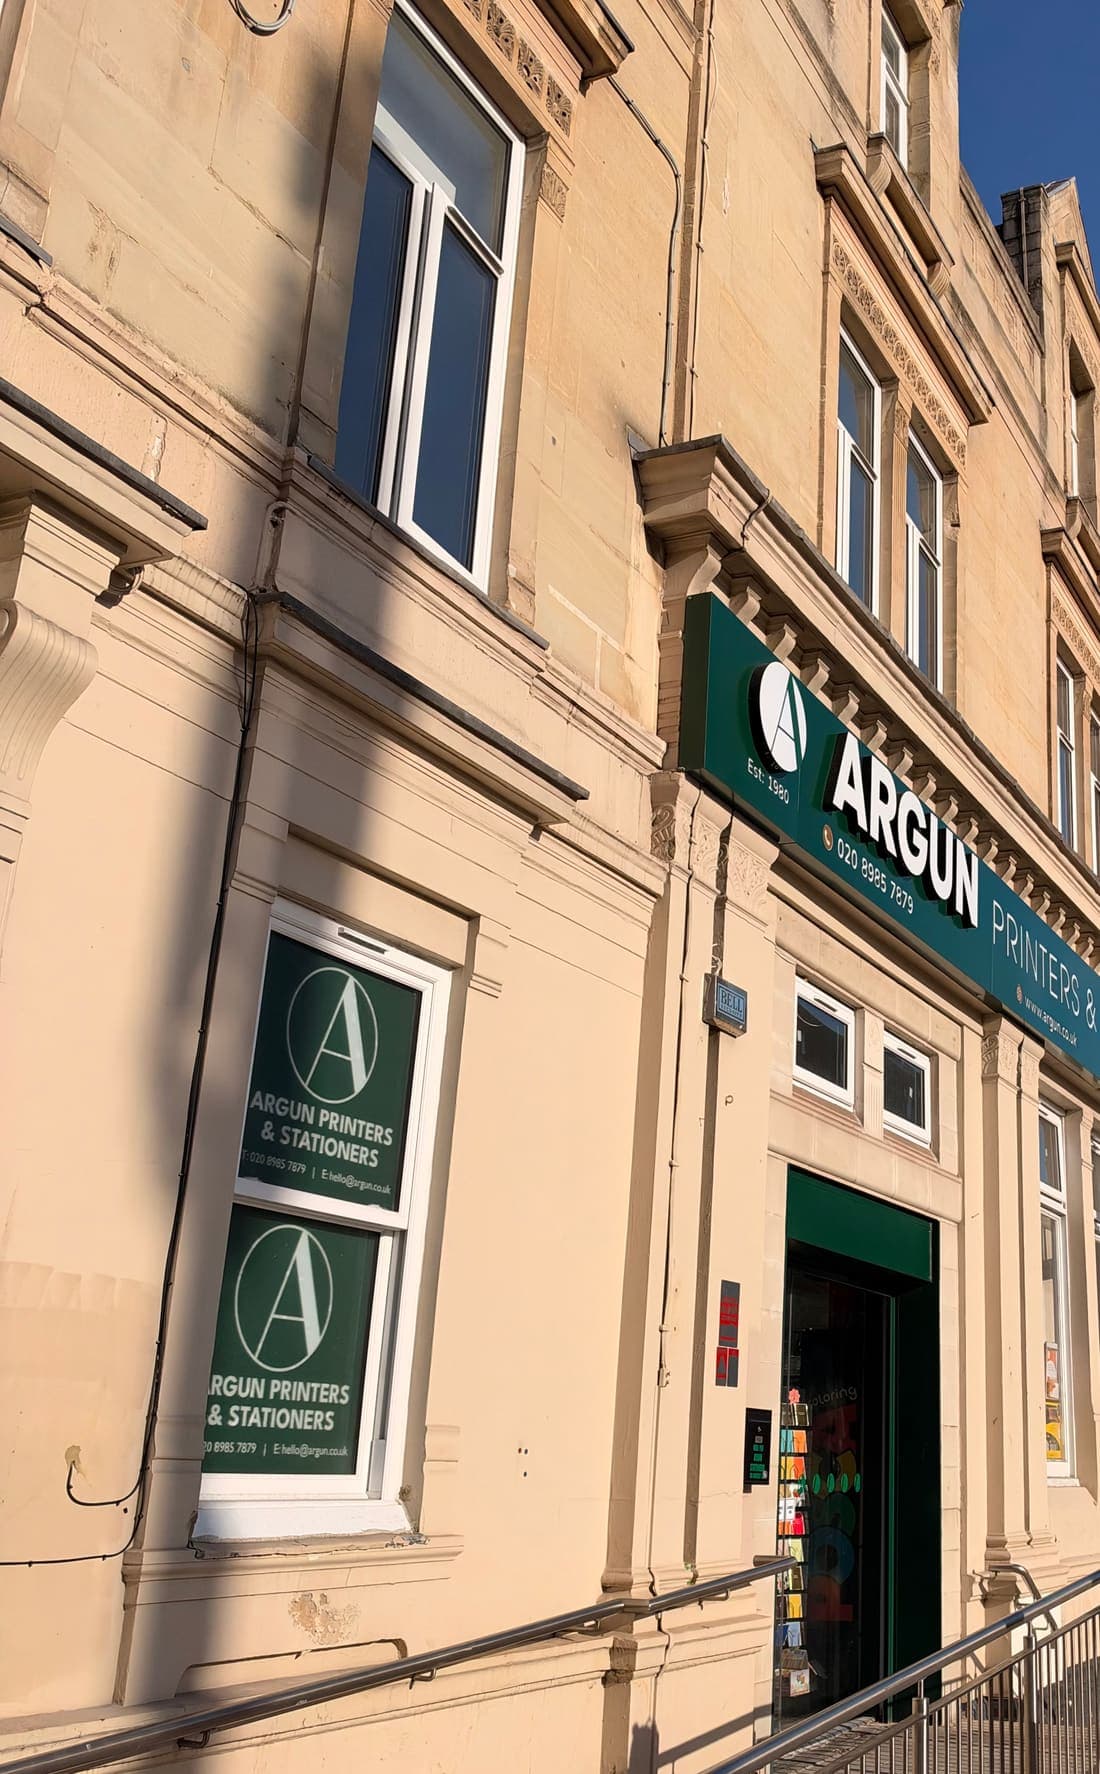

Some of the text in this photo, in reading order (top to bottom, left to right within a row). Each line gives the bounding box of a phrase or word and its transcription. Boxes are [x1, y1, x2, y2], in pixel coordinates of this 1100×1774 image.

[748, 757, 790, 804] Est: 1980
[832, 731, 979, 929] ARGUN
[837, 838, 914, 914] 020 8985 7879
[992, 899, 1098, 1033] PRINTERS &
[720, 989, 743, 1013] BELL
[1024, 996, 1078, 1048] www.argun.co.uk
[249, 1090, 394, 1146] ARGUN PRINTERS
[261, 1120, 379, 1168] & STATIONERS
[266, 1155, 286, 1169] 8985
[287, 1160, 307, 1174] 7879
[207, 1374, 350, 1405] RGUN PRINTERS
[207, 1403, 335, 1431] & STATIONERS
[213, 1441, 235, 1453] 8985
[236, 1442, 257, 1453] 7879
